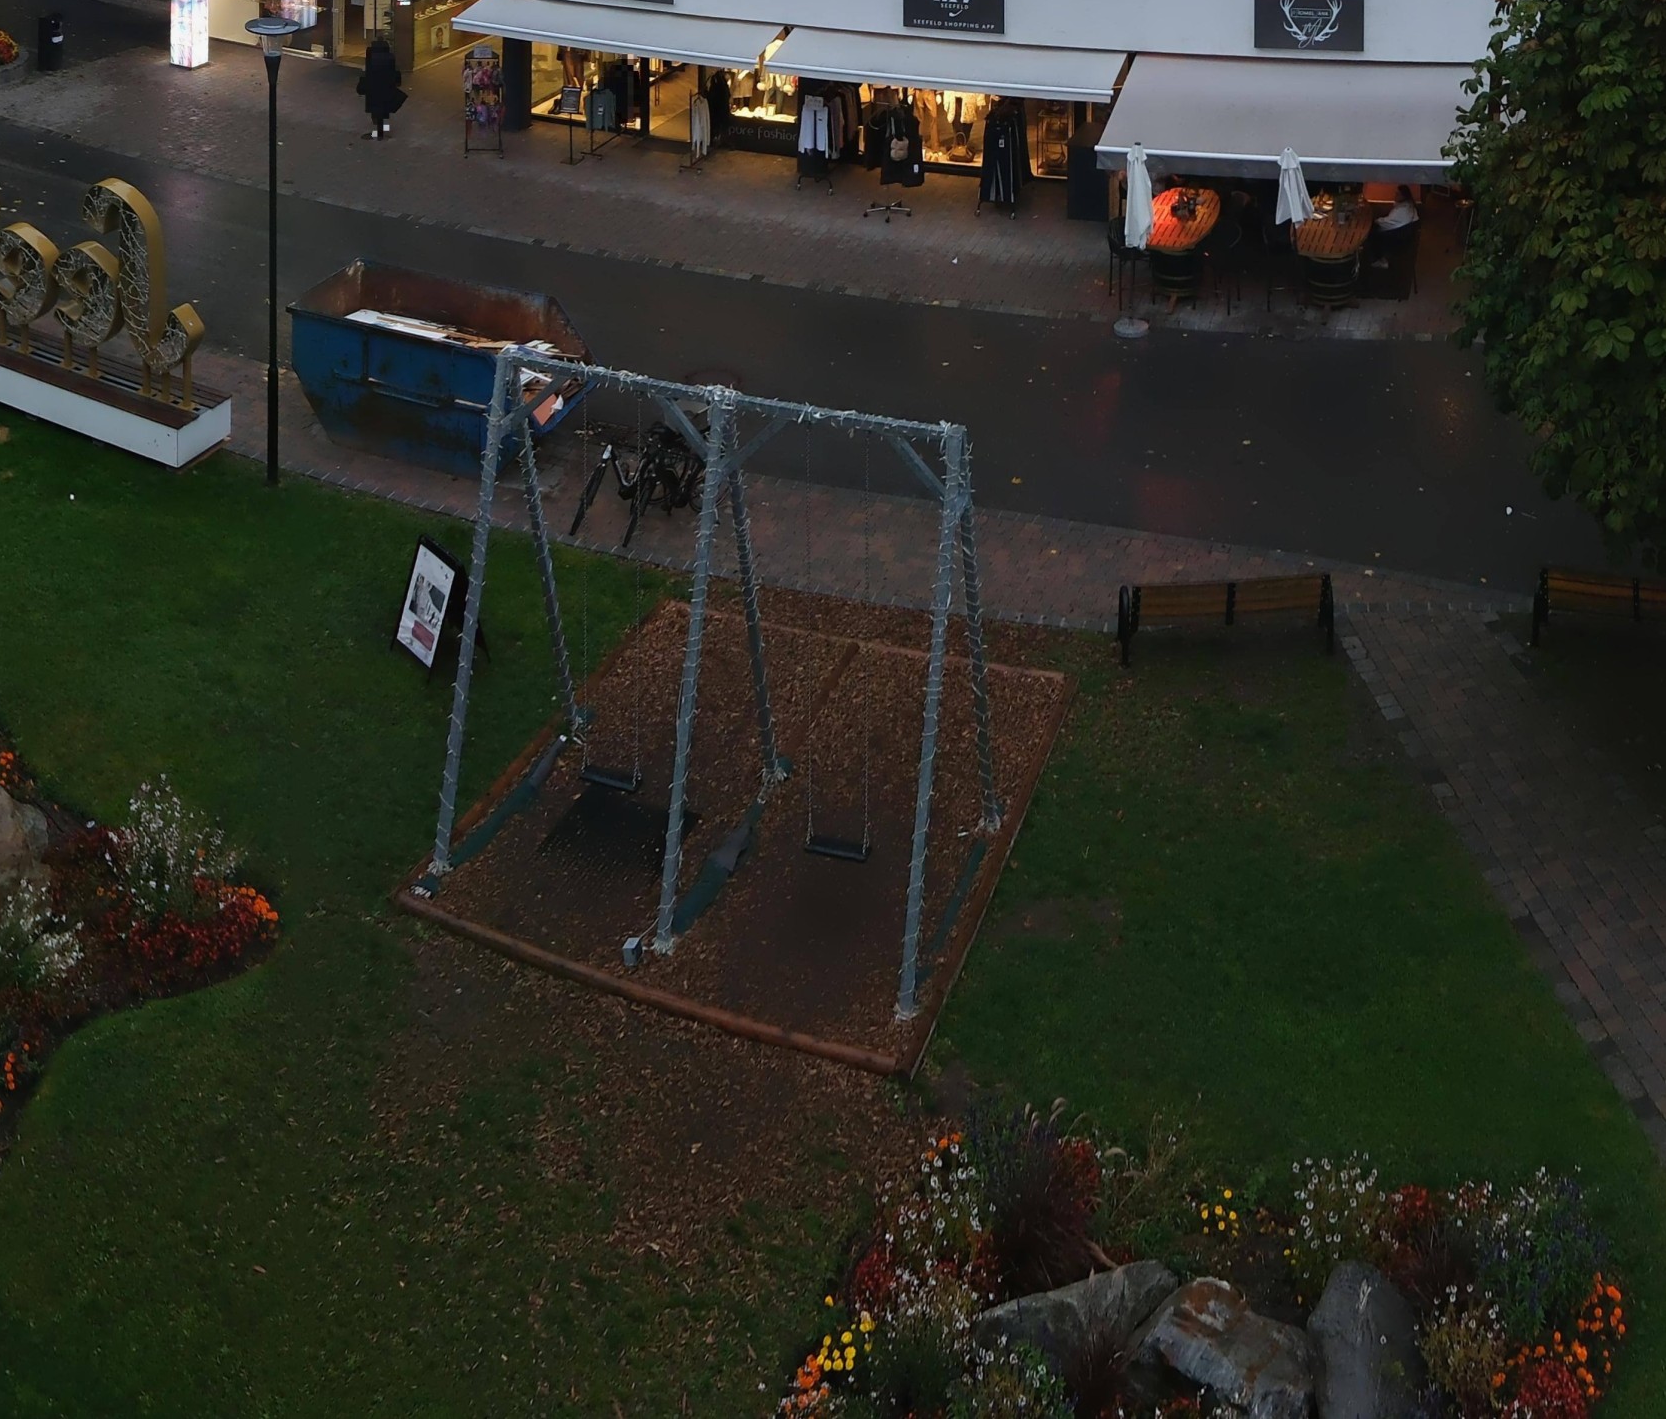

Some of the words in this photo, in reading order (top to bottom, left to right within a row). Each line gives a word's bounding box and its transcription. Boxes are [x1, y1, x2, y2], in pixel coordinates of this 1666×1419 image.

[941, 2, 969, 10] SEEFELD
[913, 19, 942, 27] SEEFELD
[944, 21, 980, 30] SHOPPING
